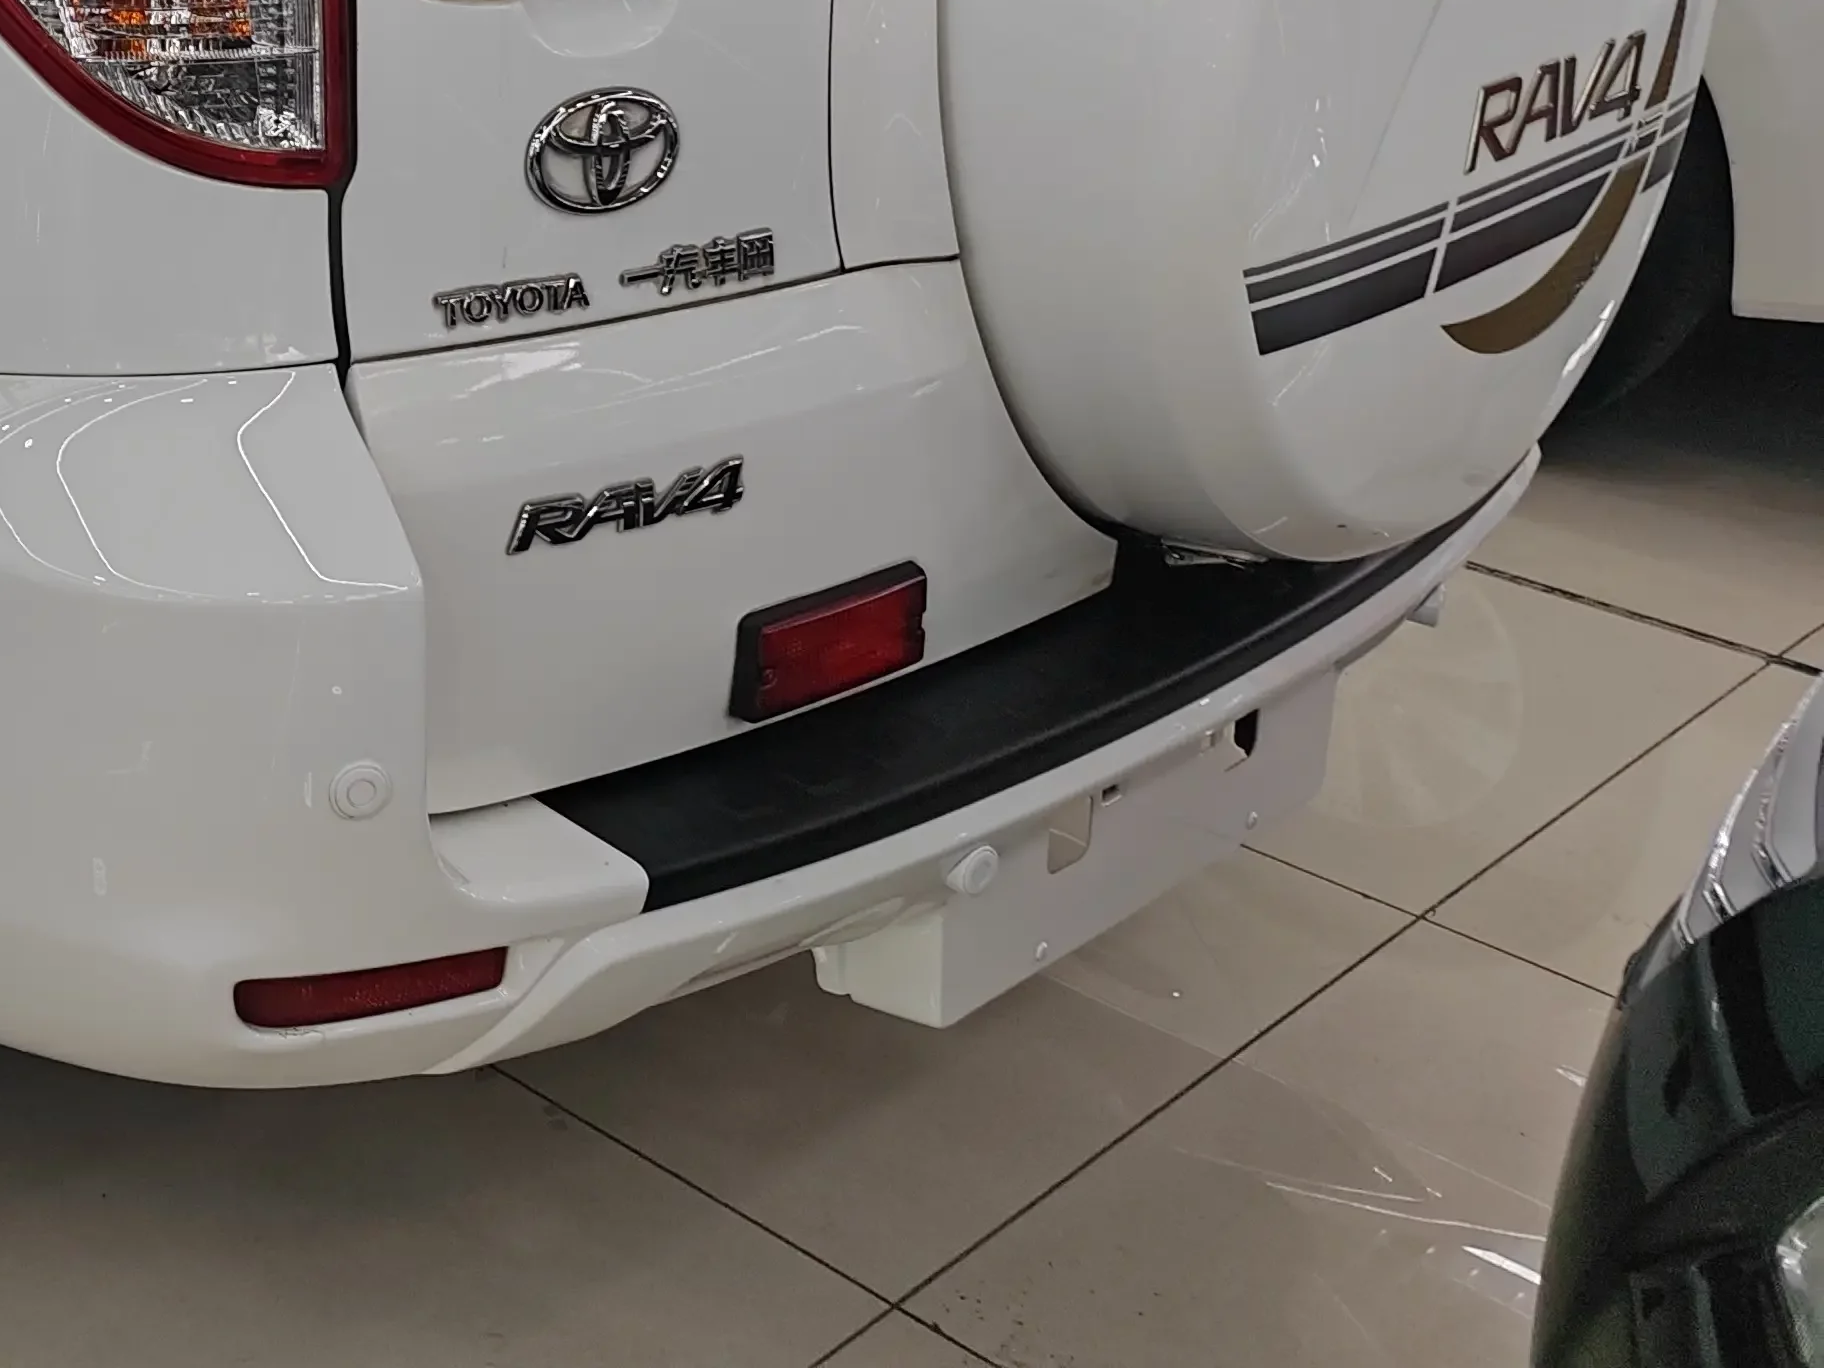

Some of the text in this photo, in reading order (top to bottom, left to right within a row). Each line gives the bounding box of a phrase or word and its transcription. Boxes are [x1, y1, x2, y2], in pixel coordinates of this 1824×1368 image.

[1464, 29, 1646, 176] RAV4
[432, 273, 591, 331] TOYOTA
[505, 454, 745, 556] RAV4
